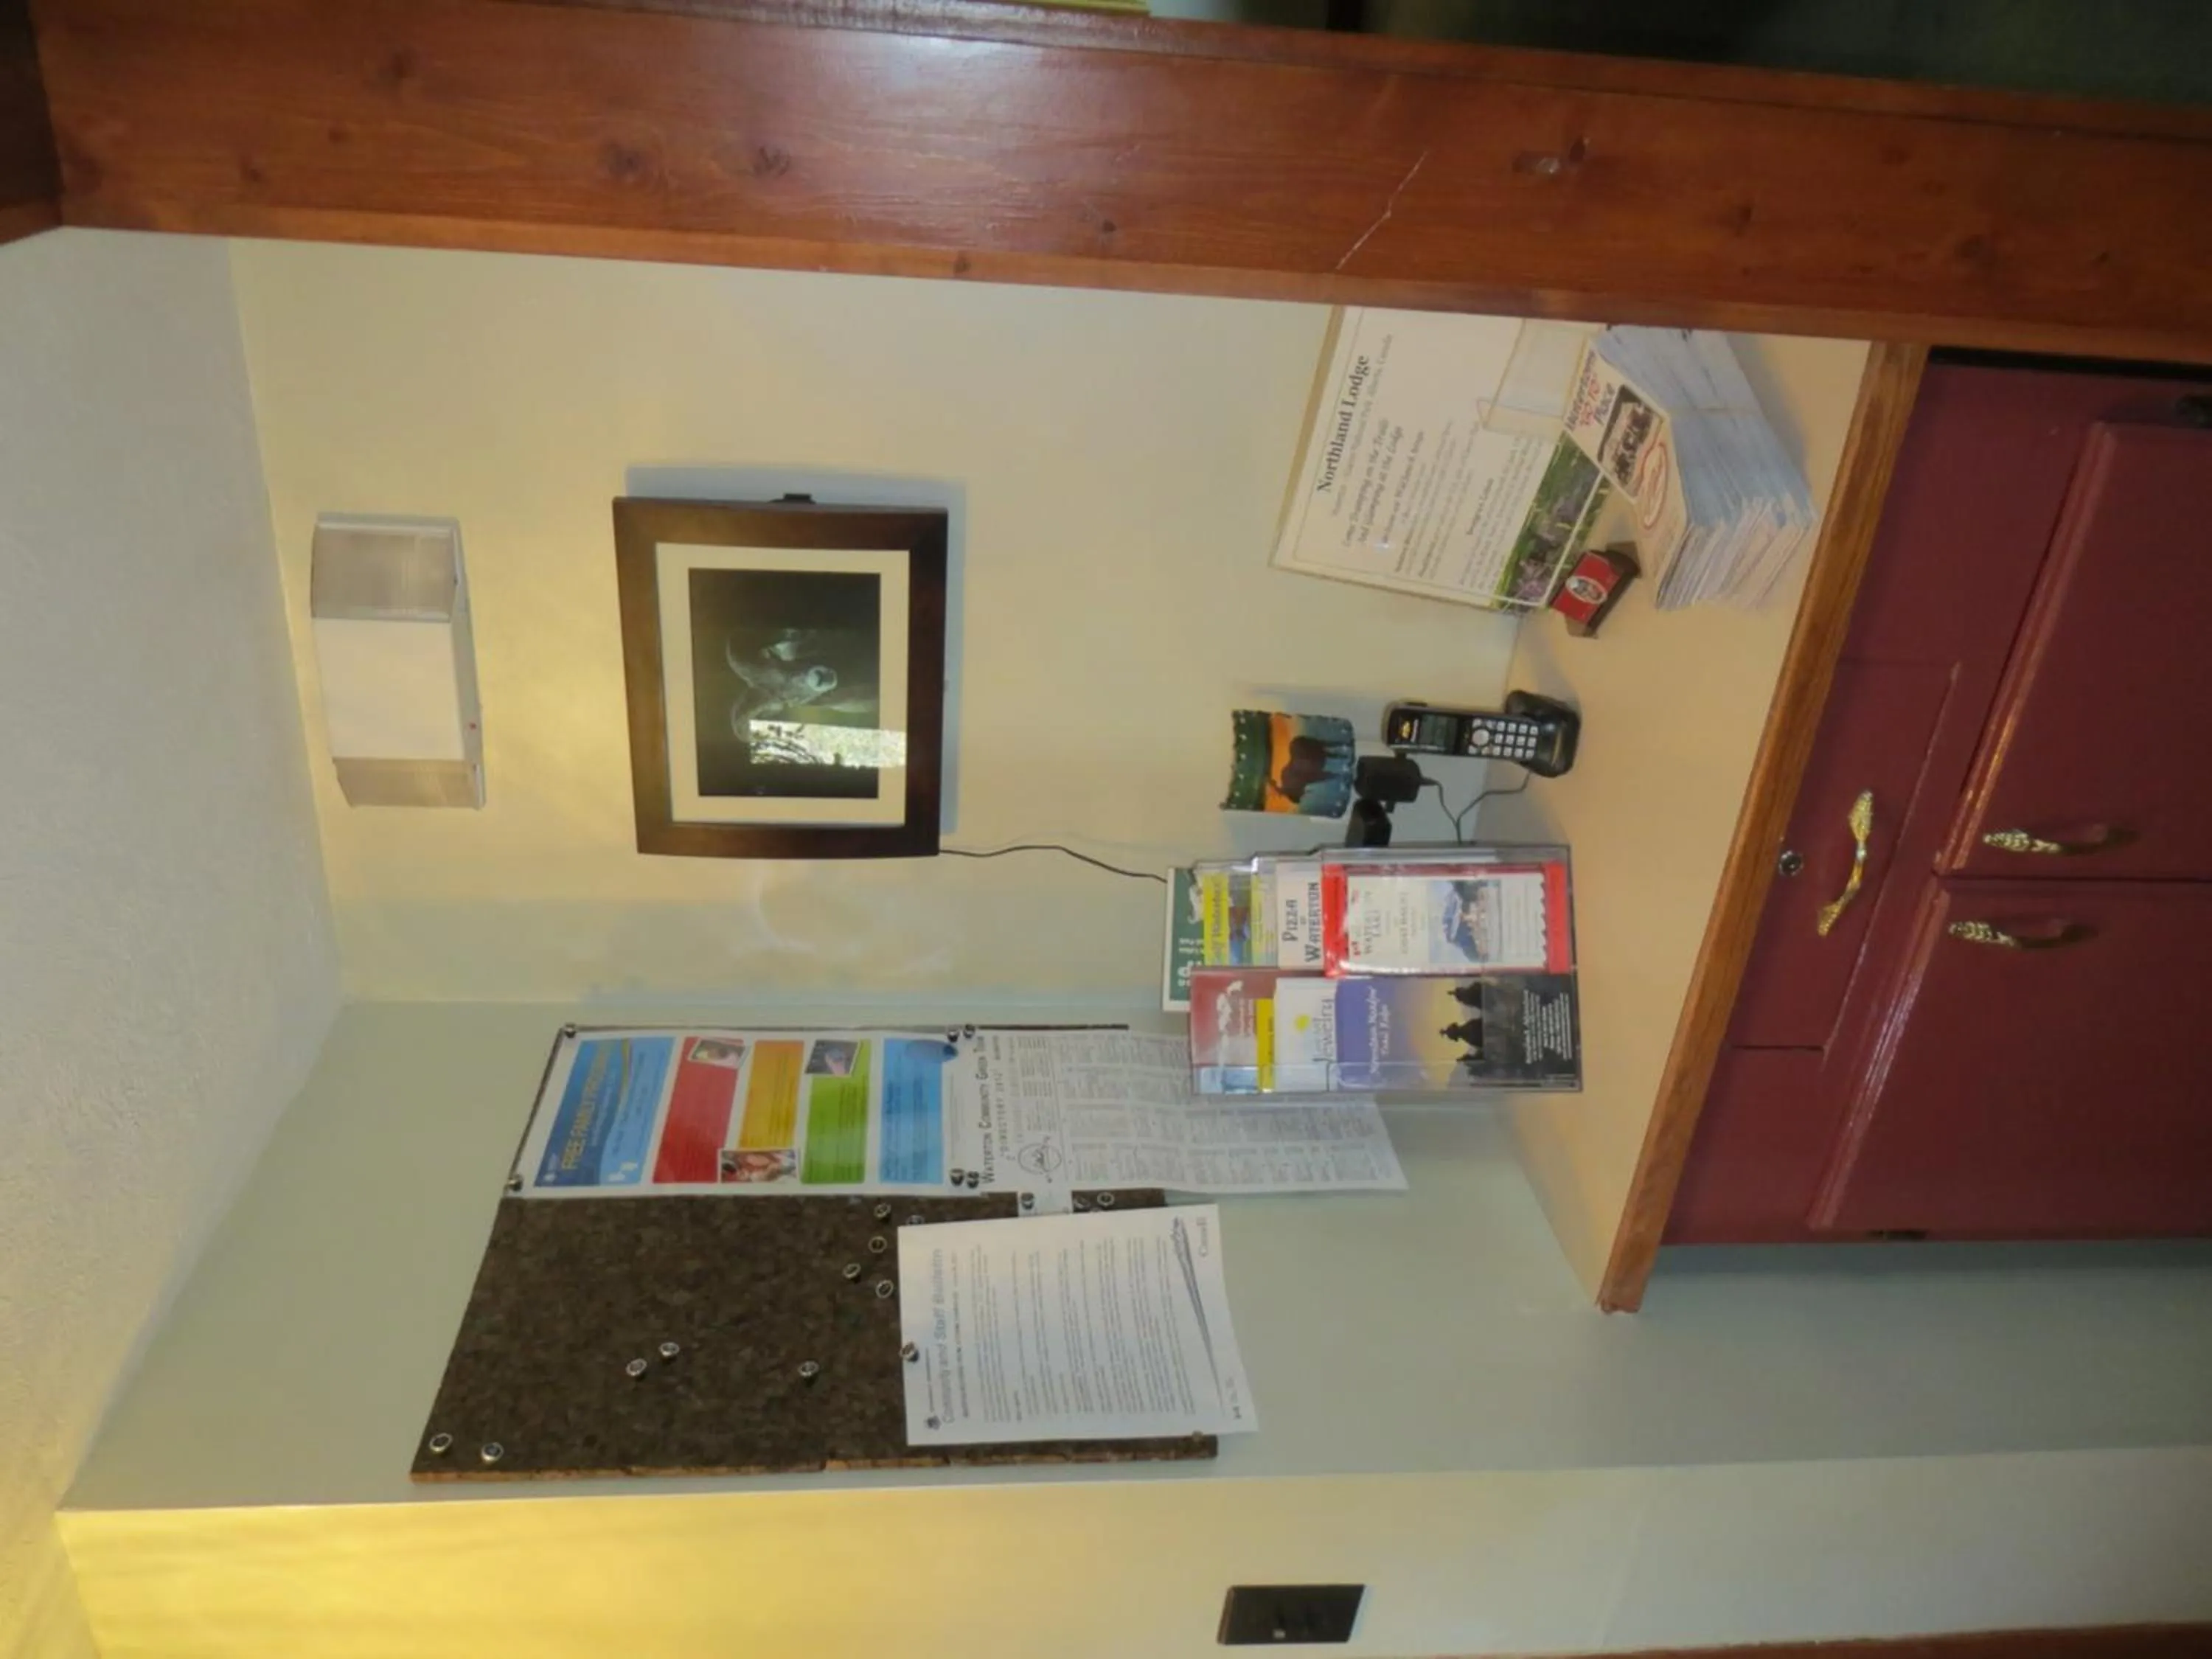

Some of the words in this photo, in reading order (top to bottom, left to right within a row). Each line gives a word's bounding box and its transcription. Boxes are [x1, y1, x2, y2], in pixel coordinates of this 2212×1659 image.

[1315, 410, 1354, 493] Northland
[1340, 354, 1371, 408] Lodge
[1304, 881, 1322, 963] WATERTON
